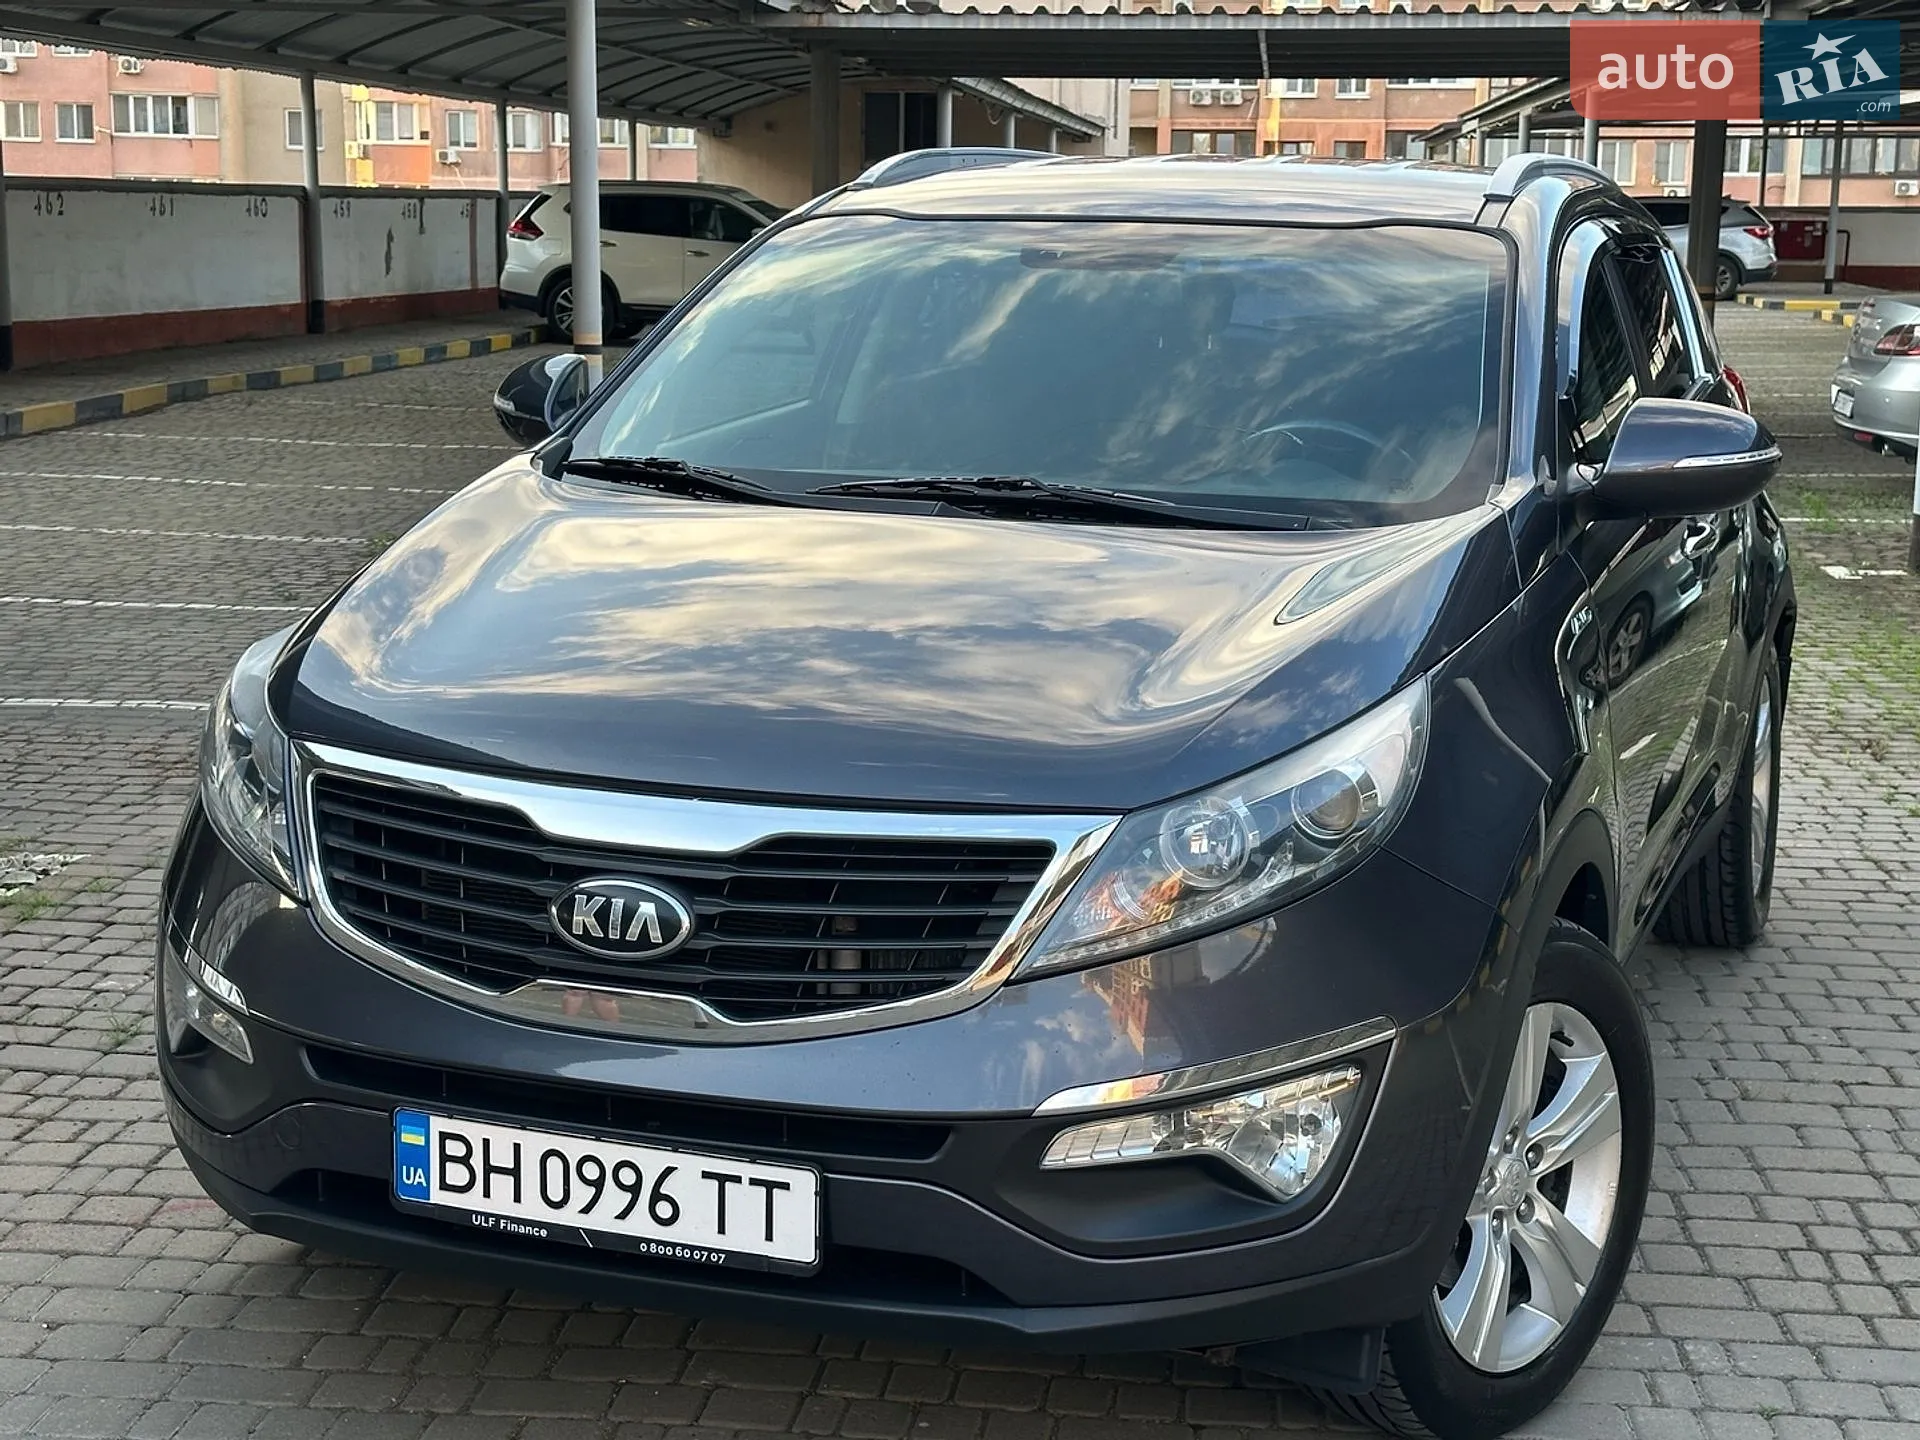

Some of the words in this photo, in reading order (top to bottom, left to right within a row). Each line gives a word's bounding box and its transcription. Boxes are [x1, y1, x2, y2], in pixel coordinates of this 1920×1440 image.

[34, 192, 64, 217] 462
[150, 195, 175, 217] 461
[245, 197, 269, 218] 460
[572, 894, 663, 944] KIA
[402, 1165, 427, 1188] UA
[438, 1130, 522, 1204] BH
[539, 1148, 681, 1227] 0996
[701, 1170, 791, 1243] TT
[471, 1213, 496, 1228] ULF
[500, 1219, 549, 1238] Finance
